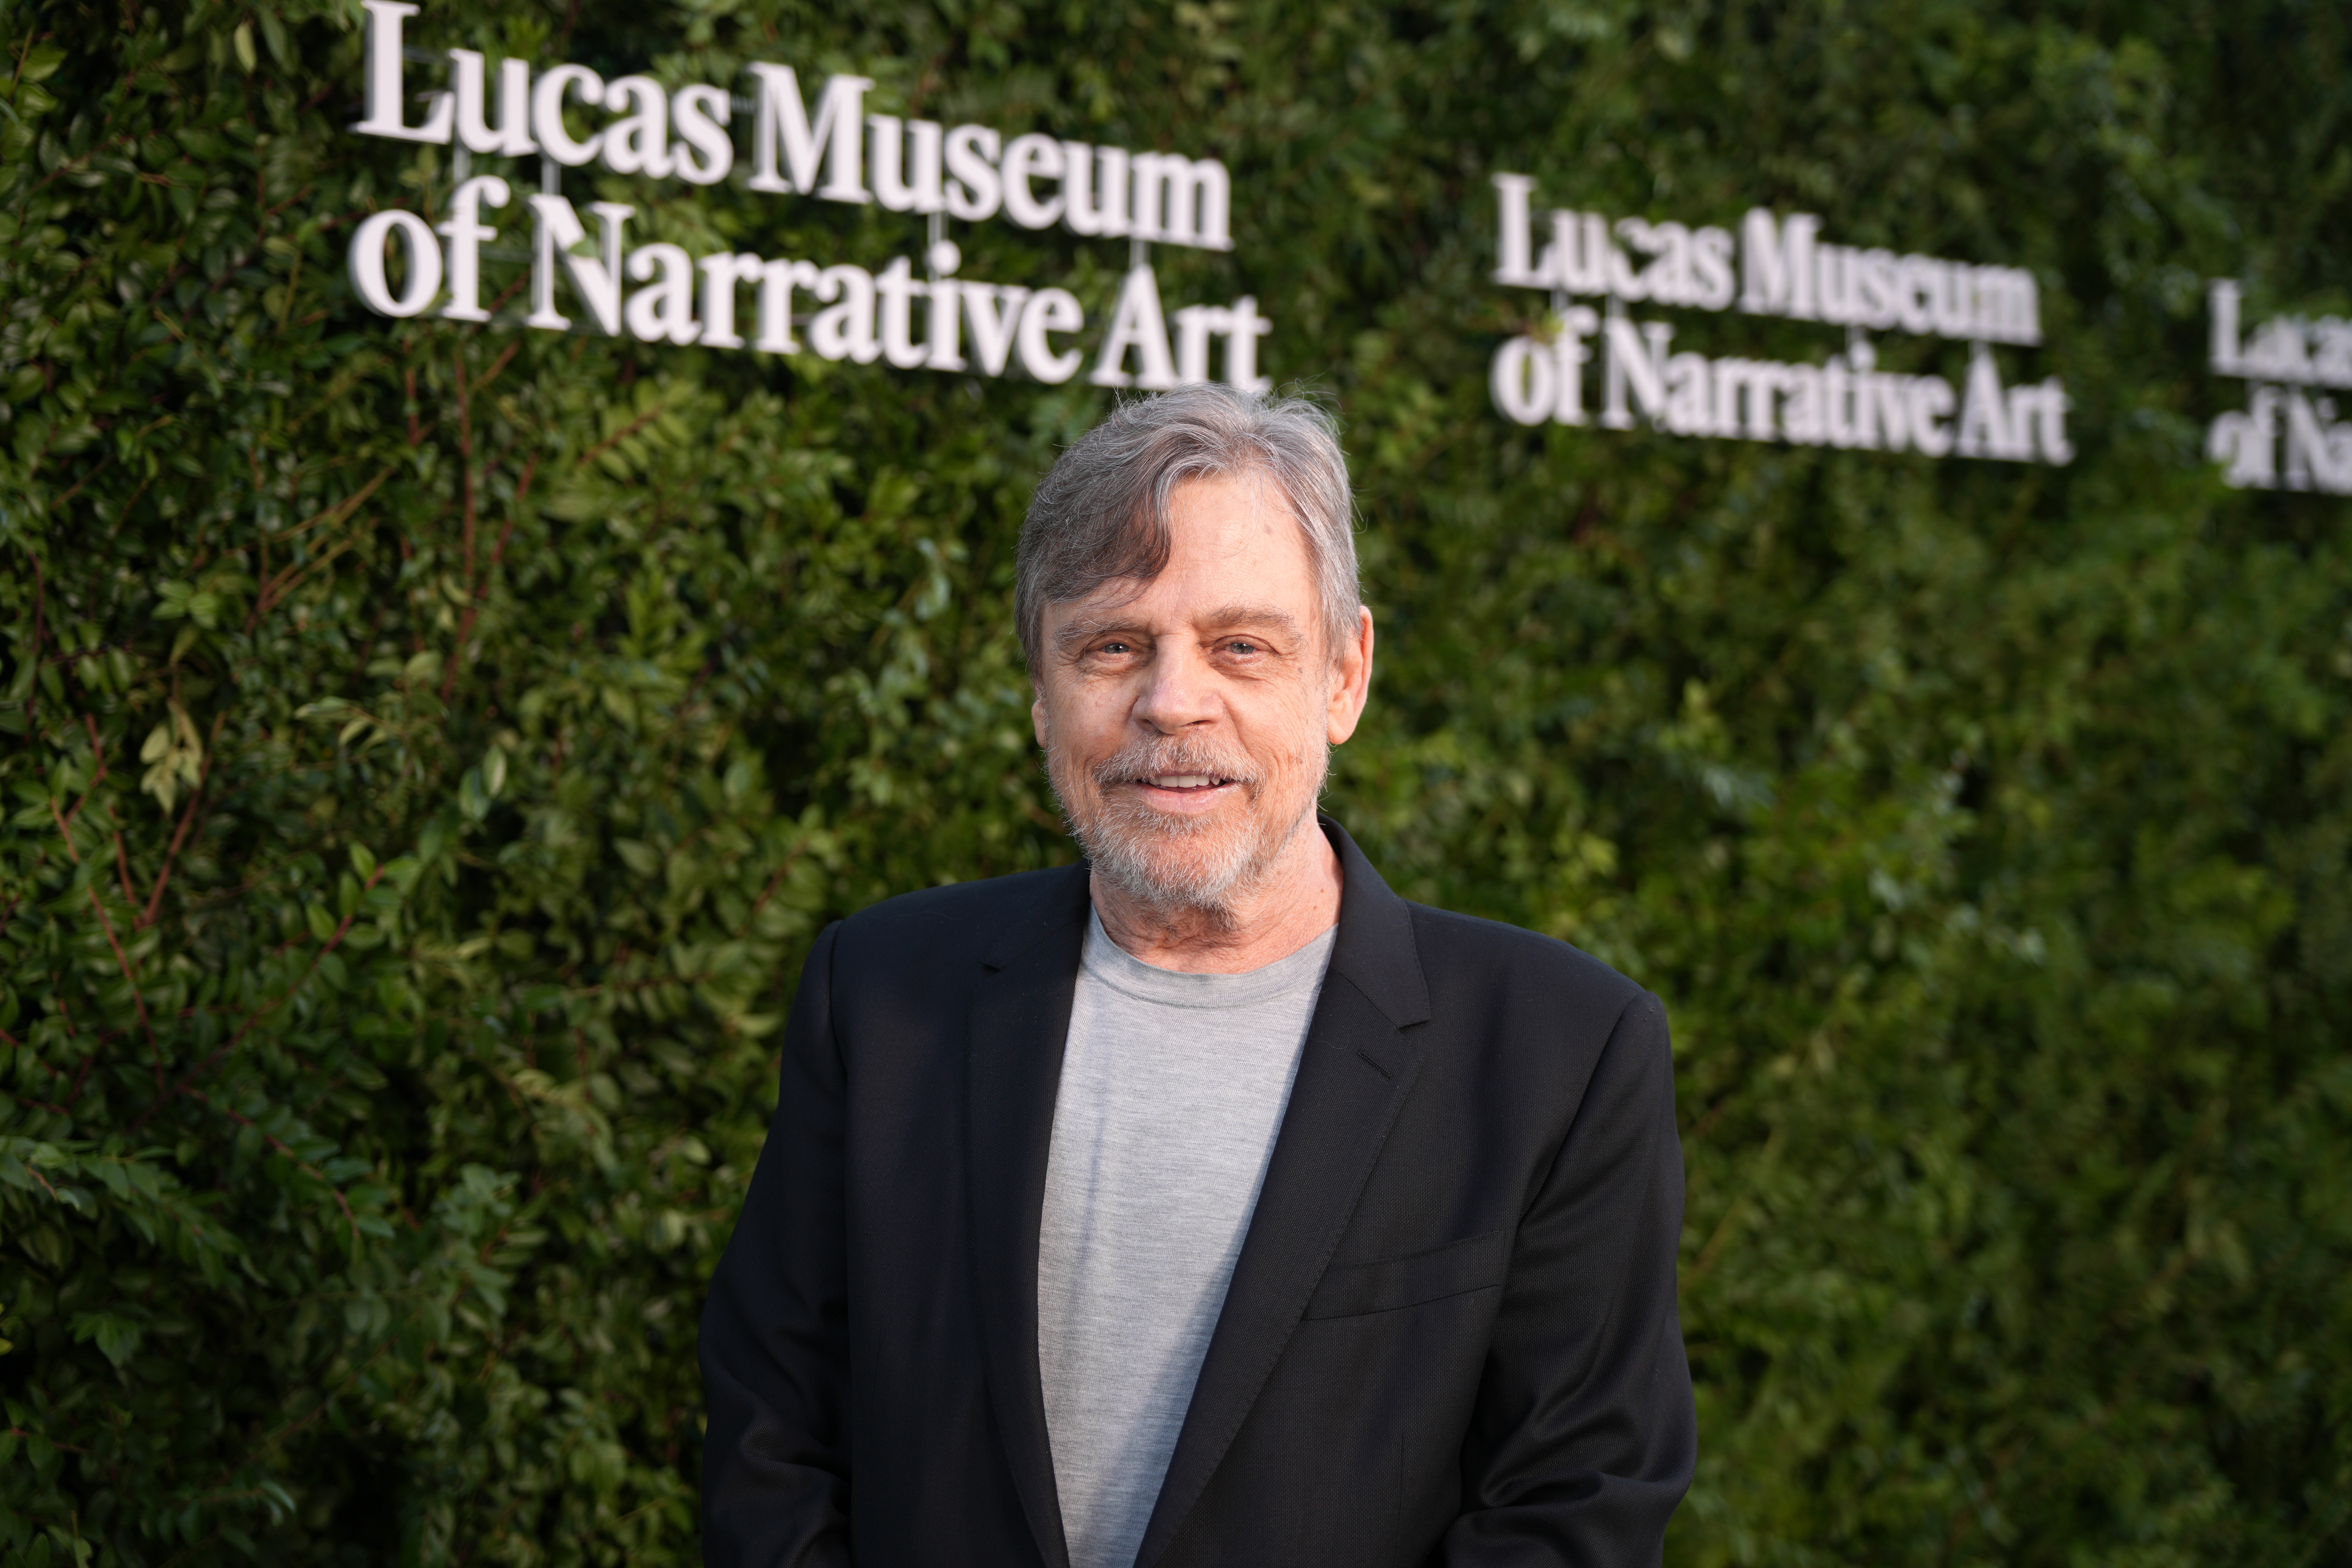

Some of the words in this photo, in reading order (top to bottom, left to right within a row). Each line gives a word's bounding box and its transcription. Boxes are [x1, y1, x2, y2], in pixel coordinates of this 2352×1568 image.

[352, 0, 734, 185] Lucas
[750, 61, 1234, 251] Museum
[350, 175, 511, 323] of
[527, 193, 1085, 384] Narrative
[1090, 263, 1273, 394] Art
[1493, 173, 1736, 311] Lucas
[1742, 207, 2042, 346] Museum
[1492, 306, 1597, 427] of
[1602, 315, 1956, 457] Narrative
[1956, 343, 2075, 467] Art
